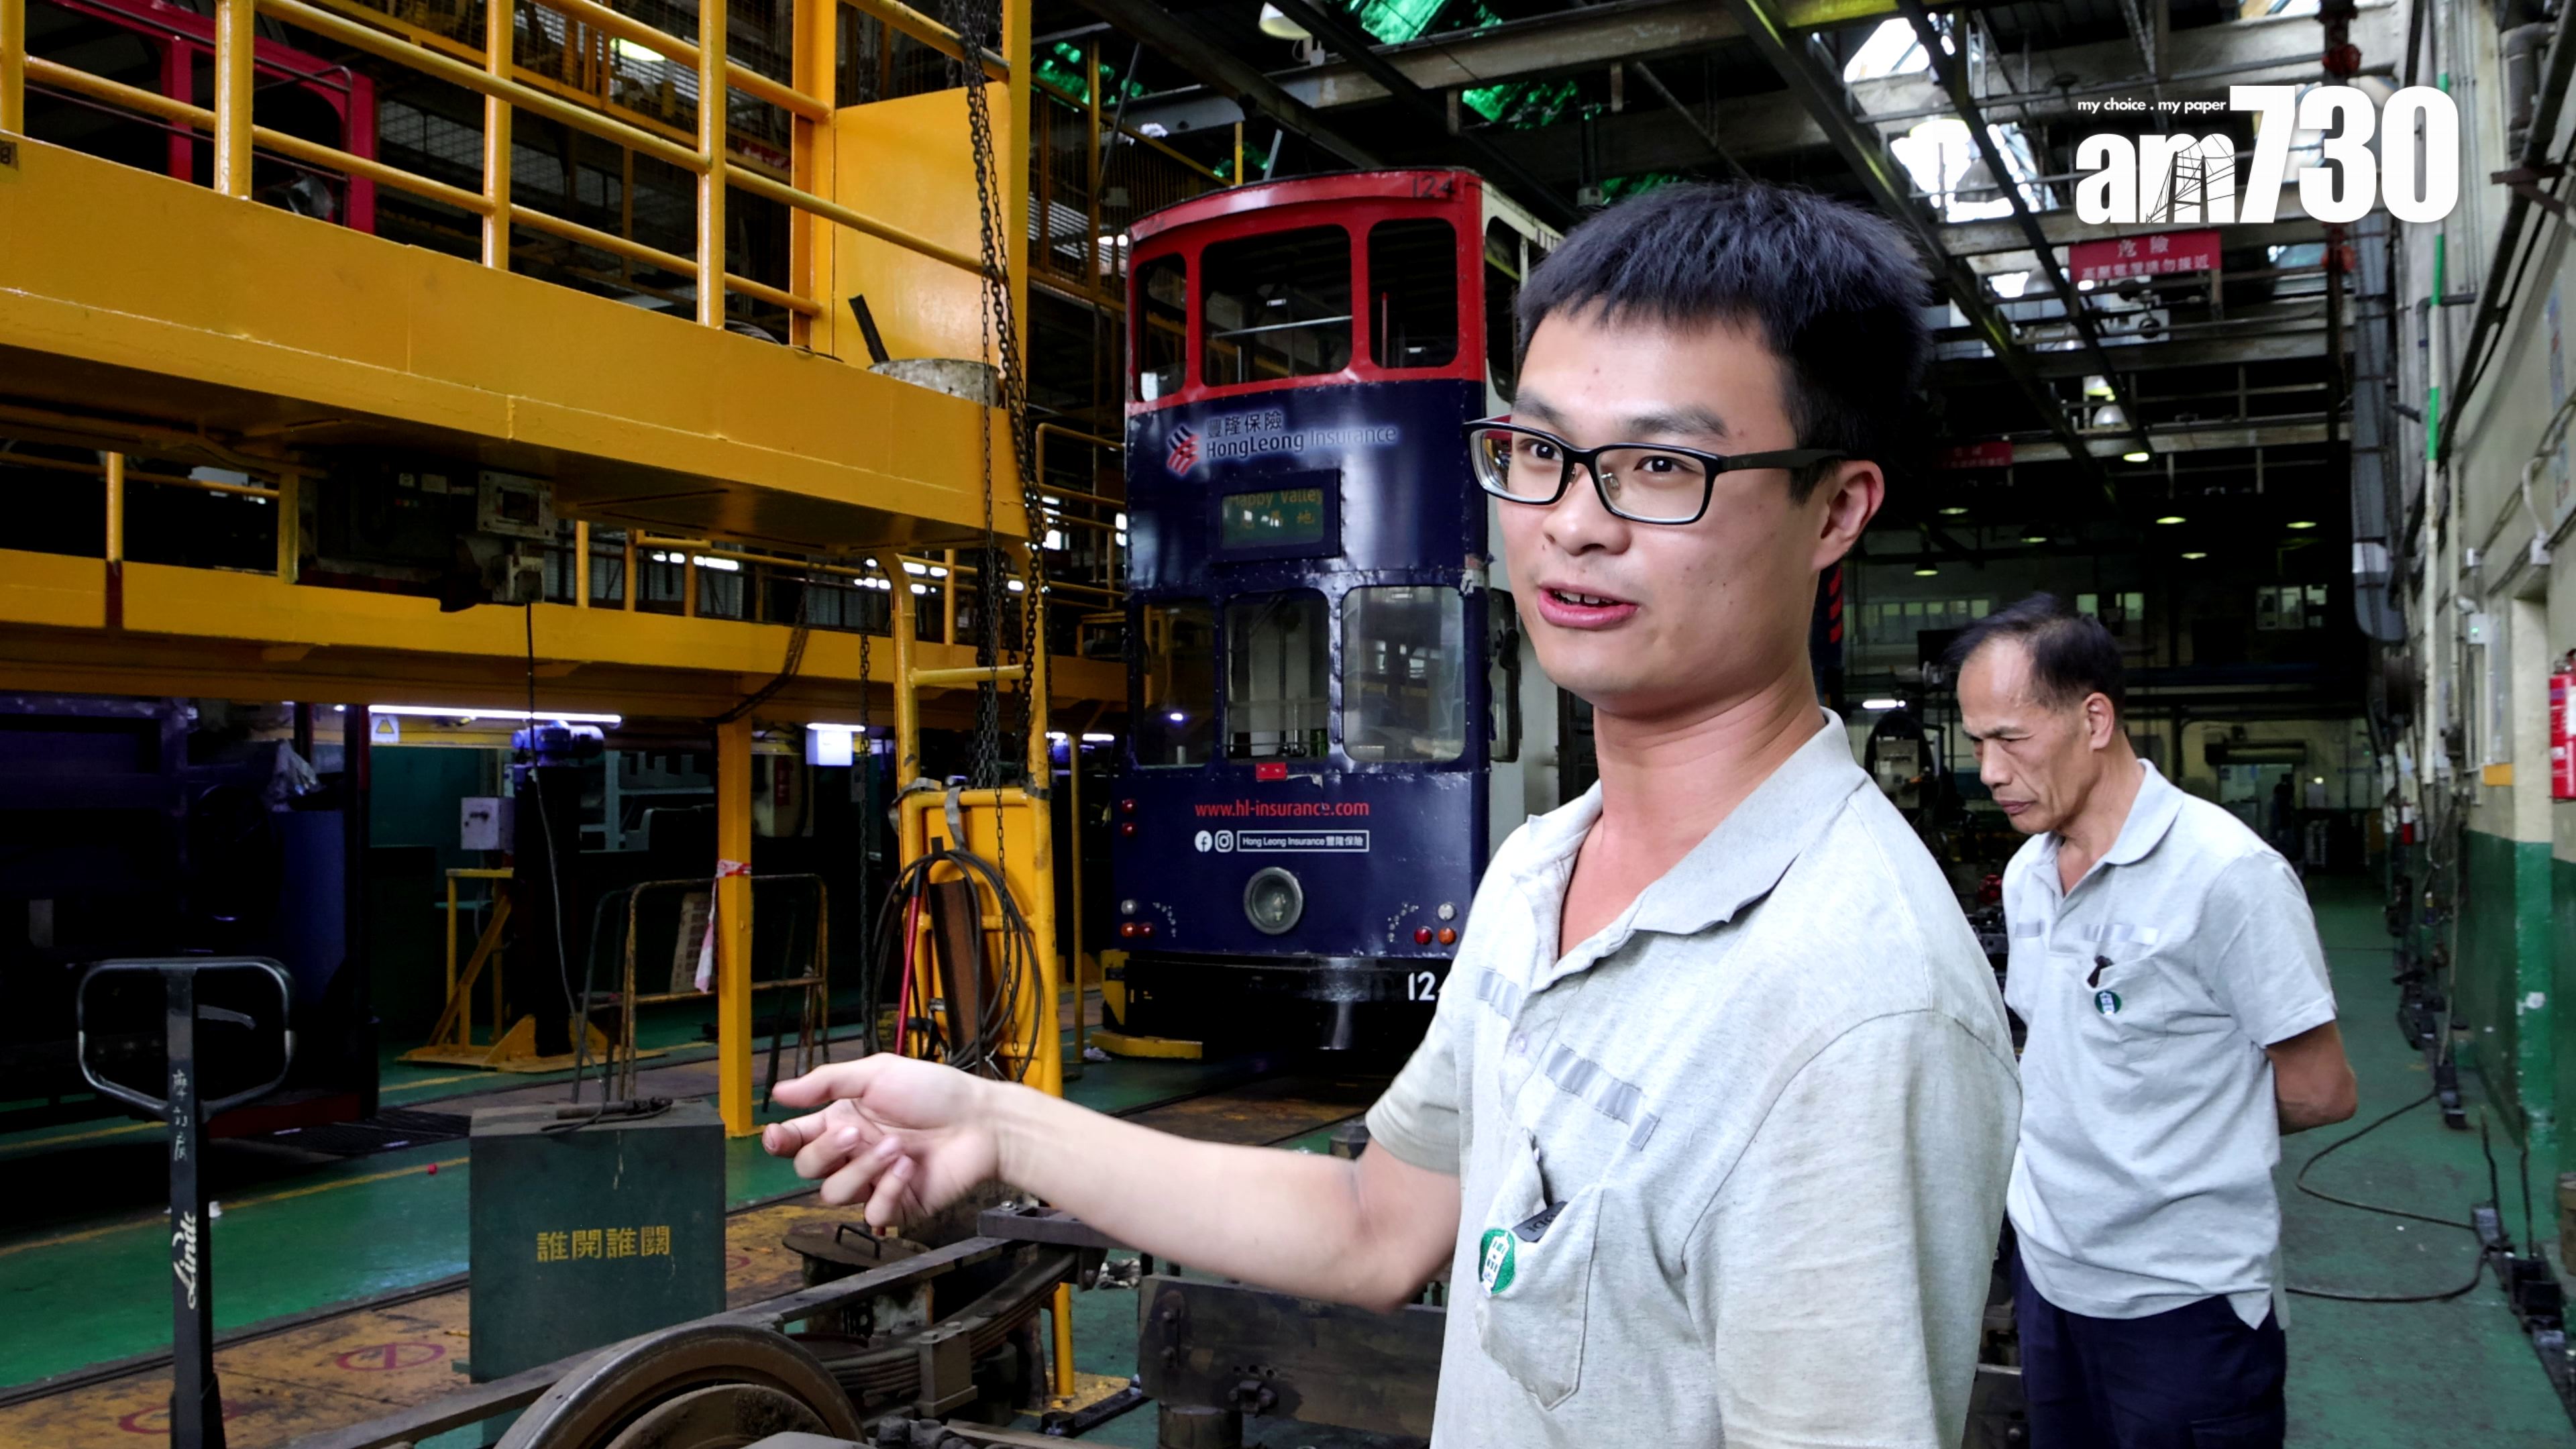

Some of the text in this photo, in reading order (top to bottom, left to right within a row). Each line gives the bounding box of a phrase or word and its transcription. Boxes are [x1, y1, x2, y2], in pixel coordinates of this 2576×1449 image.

[1412, 176, 1456, 199] 124
[1208, 411, 1282, 437] 豐隆保險
[1311, 427, 1397, 446] Insurance
[1195, 799, 1370, 816] www.hl-insurance.com
[1242, 837, 1262, 847] Hong
[1263, 837, 1287, 847] Leong
[1287, 837, 1326, 847] Insurance
[1407, 970, 1440, 1001] 12
[537, 1225, 671, 1263] 誰開誰關
